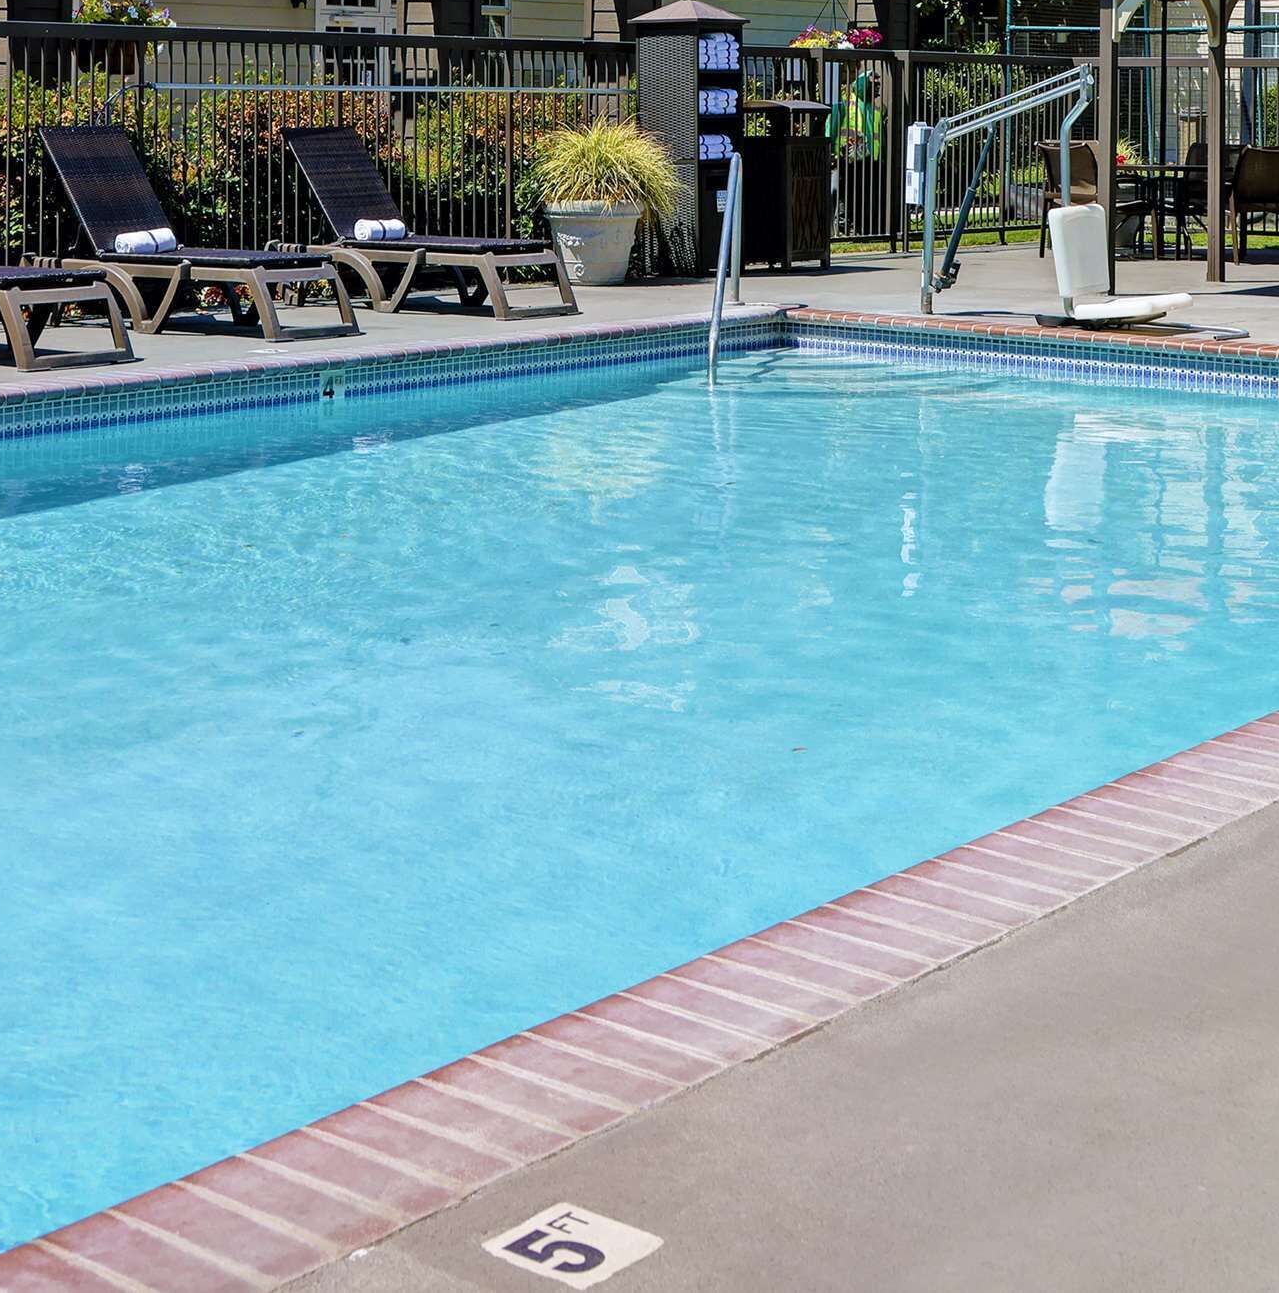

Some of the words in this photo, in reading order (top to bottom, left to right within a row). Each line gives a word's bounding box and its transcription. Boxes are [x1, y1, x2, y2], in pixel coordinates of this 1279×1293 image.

[323, 376, 334, 398] 4
[547, 1211, 590, 1234] FT
[502, 1229, 605, 1272] 5
